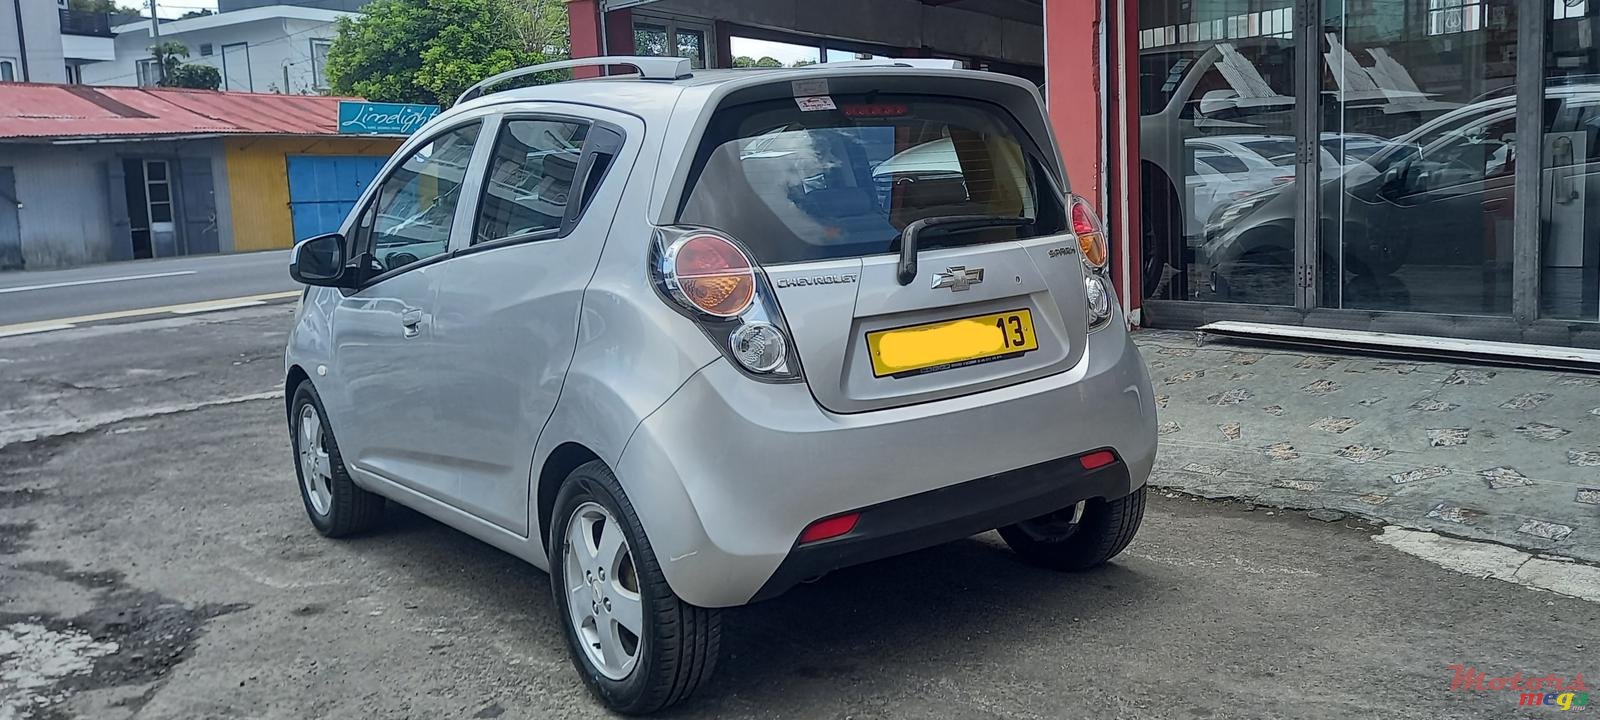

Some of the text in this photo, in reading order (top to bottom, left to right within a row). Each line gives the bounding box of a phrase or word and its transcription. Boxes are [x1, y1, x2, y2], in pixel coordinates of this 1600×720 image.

[342, 105, 438, 133] Limelight
[777, 273, 857, 288] CHEVROLET
[996, 315, 1025, 349] 13
